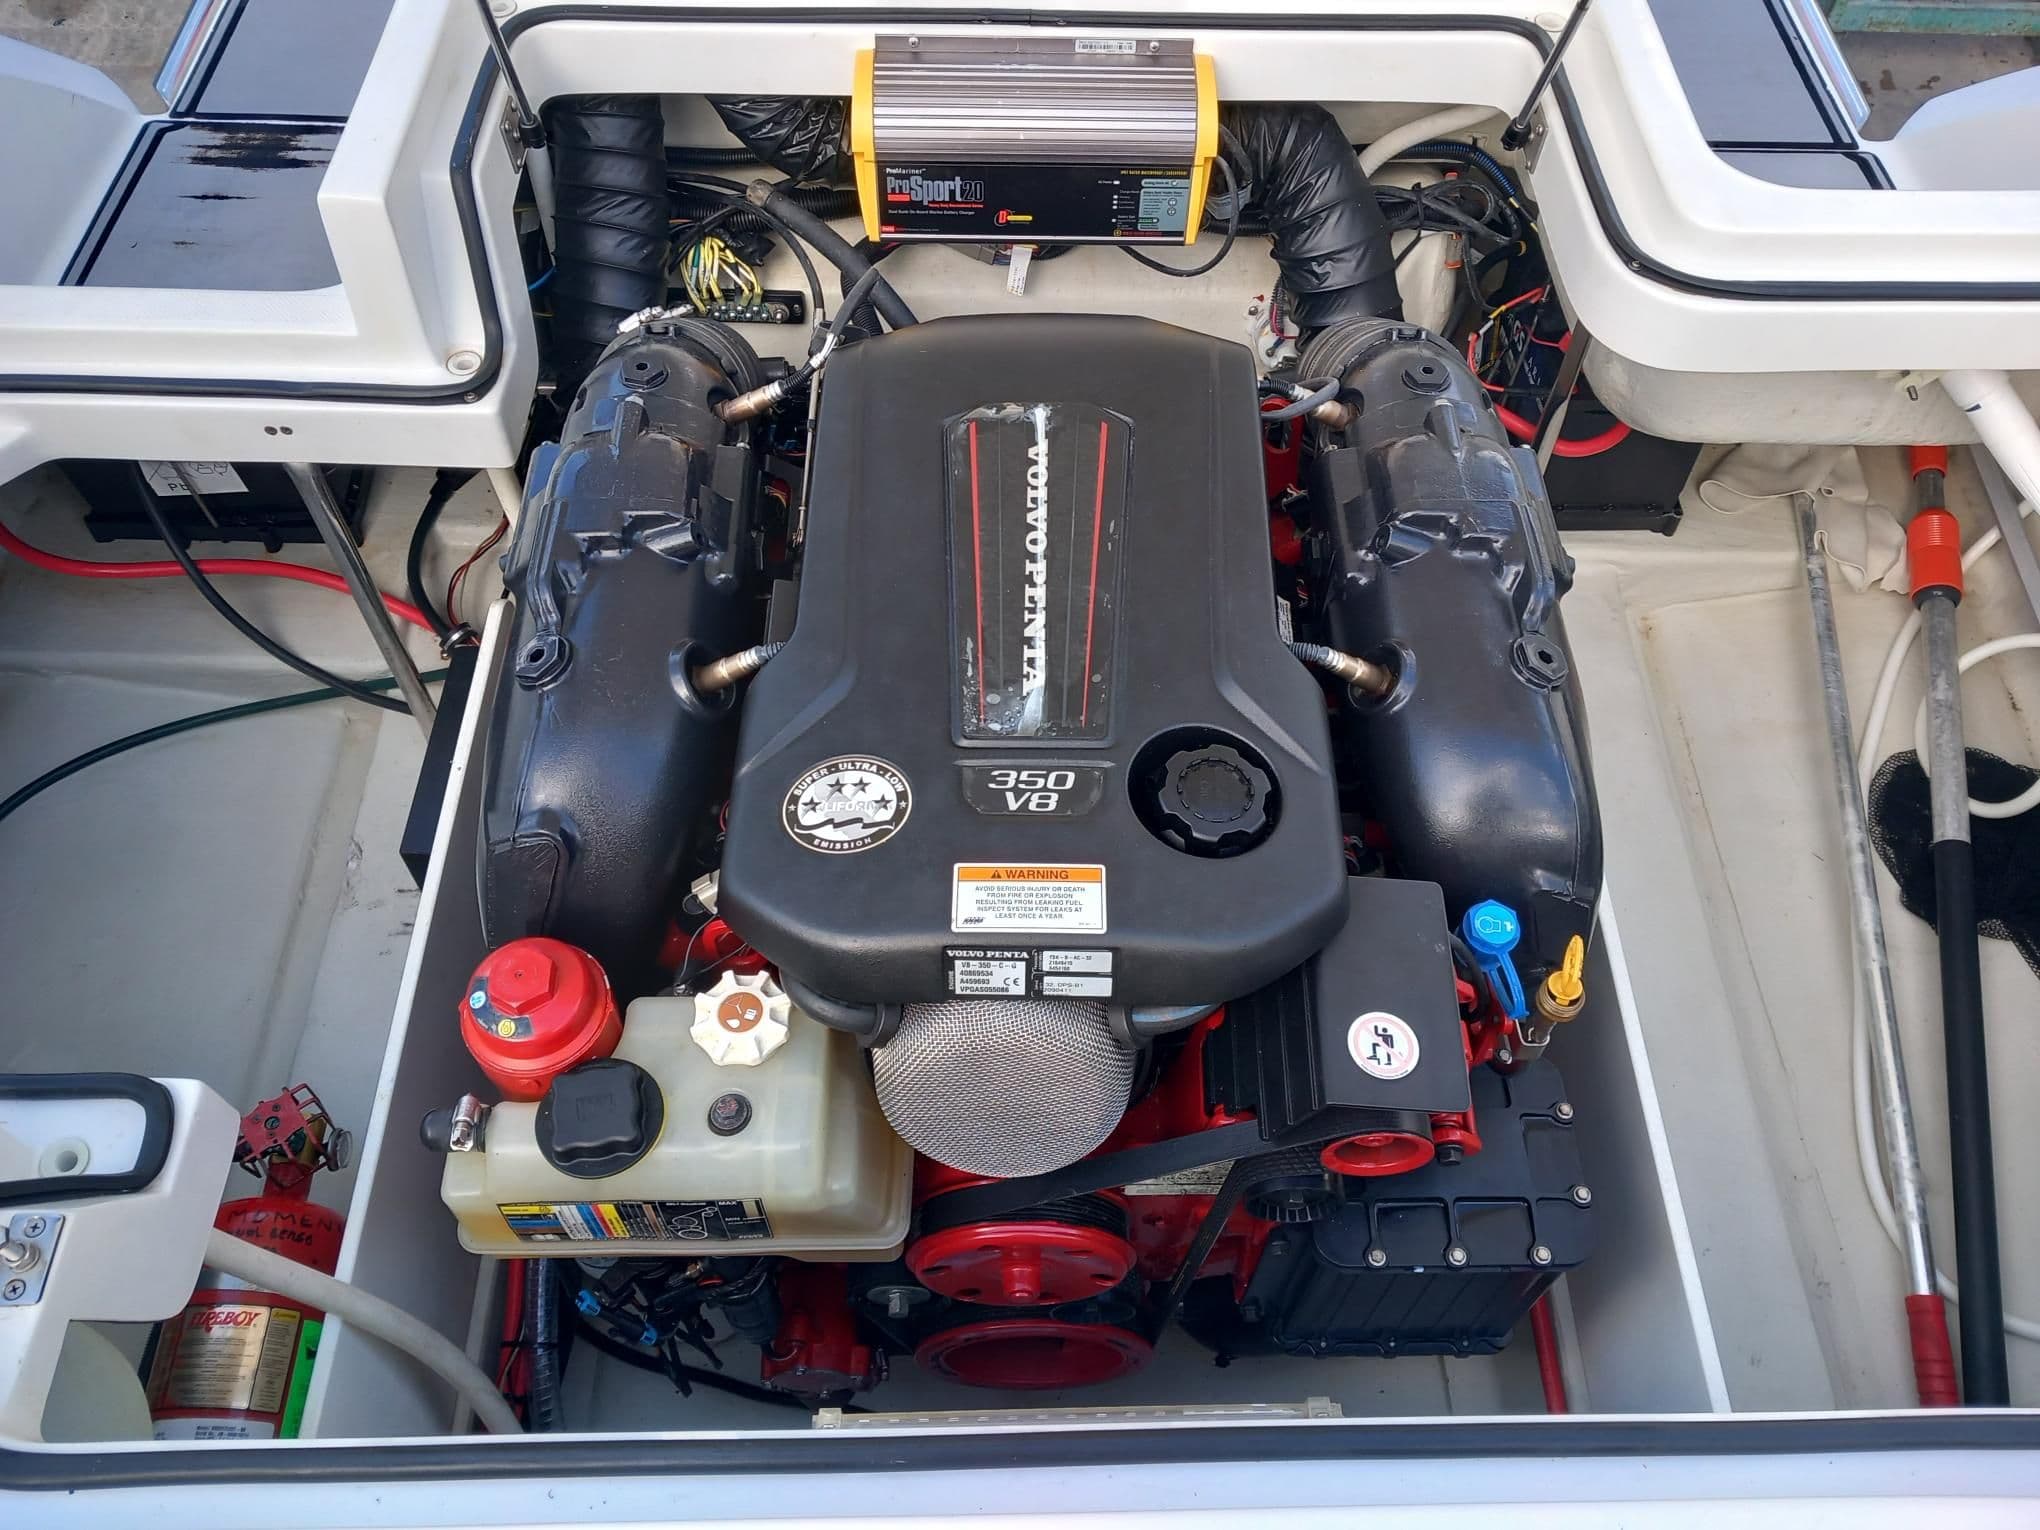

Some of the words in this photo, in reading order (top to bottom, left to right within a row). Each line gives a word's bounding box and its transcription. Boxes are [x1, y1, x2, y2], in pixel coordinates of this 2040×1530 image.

[1025, 438, 1049, 553] VOLVO
[1023, 559, 1047, 696] PENTA
[838, 762, 878, 773] ULTRA
[884, 770, 905, 793] LOW
[987, 770, 1076, 790] 350
[1004, 791, 1059, 812] V8
[813, 836, 872, 850] EMISSION
[1005, 870, 1069, 880] WARNING
[986, 950, 1030, 959] PENTA
